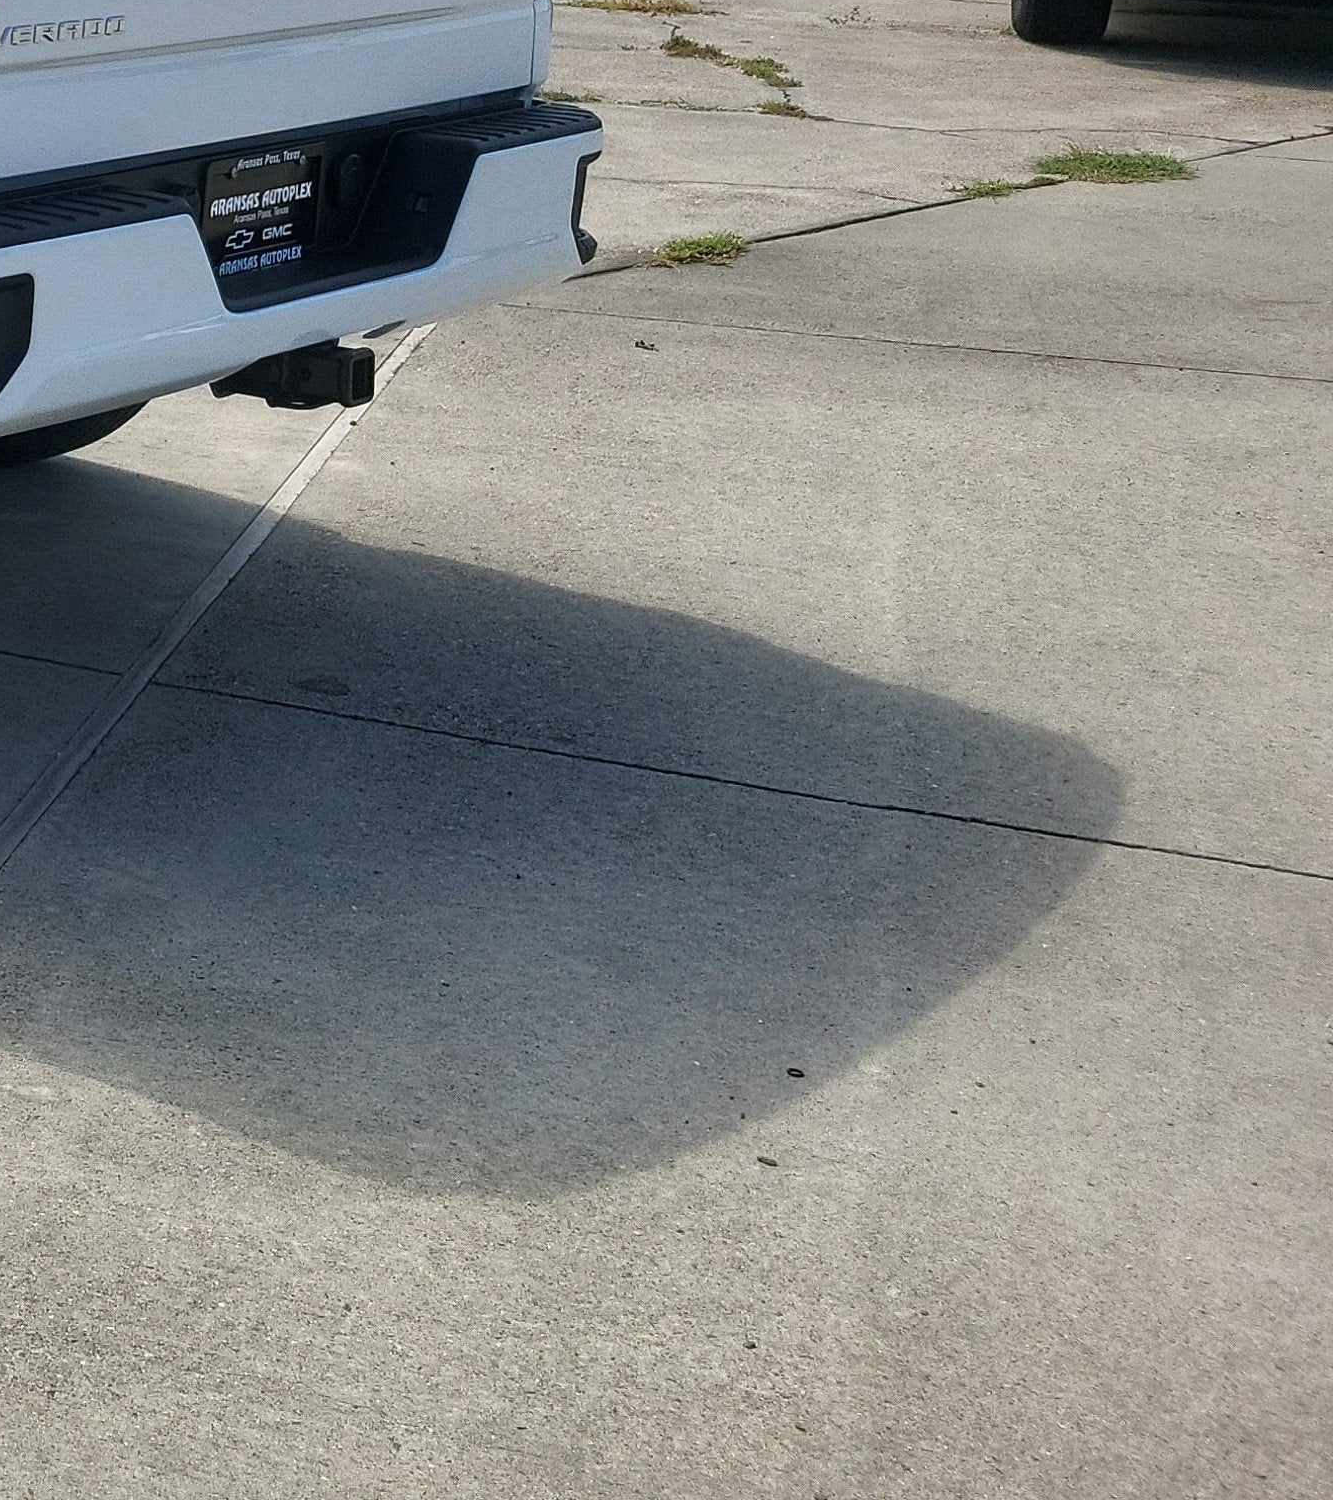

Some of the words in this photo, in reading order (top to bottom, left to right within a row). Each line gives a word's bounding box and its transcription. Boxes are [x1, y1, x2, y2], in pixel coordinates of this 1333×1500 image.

[236, 156, 263, 170] Aransas
[283, 150, 301, 162] Texas
[210, 191, 260, 218] ARANSAS
[261, 181, 313, 206] AUTOPLEX
[262, 223, 293, 240] GMC
[219, 257, 258, 276] ARANSAS
[260, 245, 302, 267] AUTOPLEX
